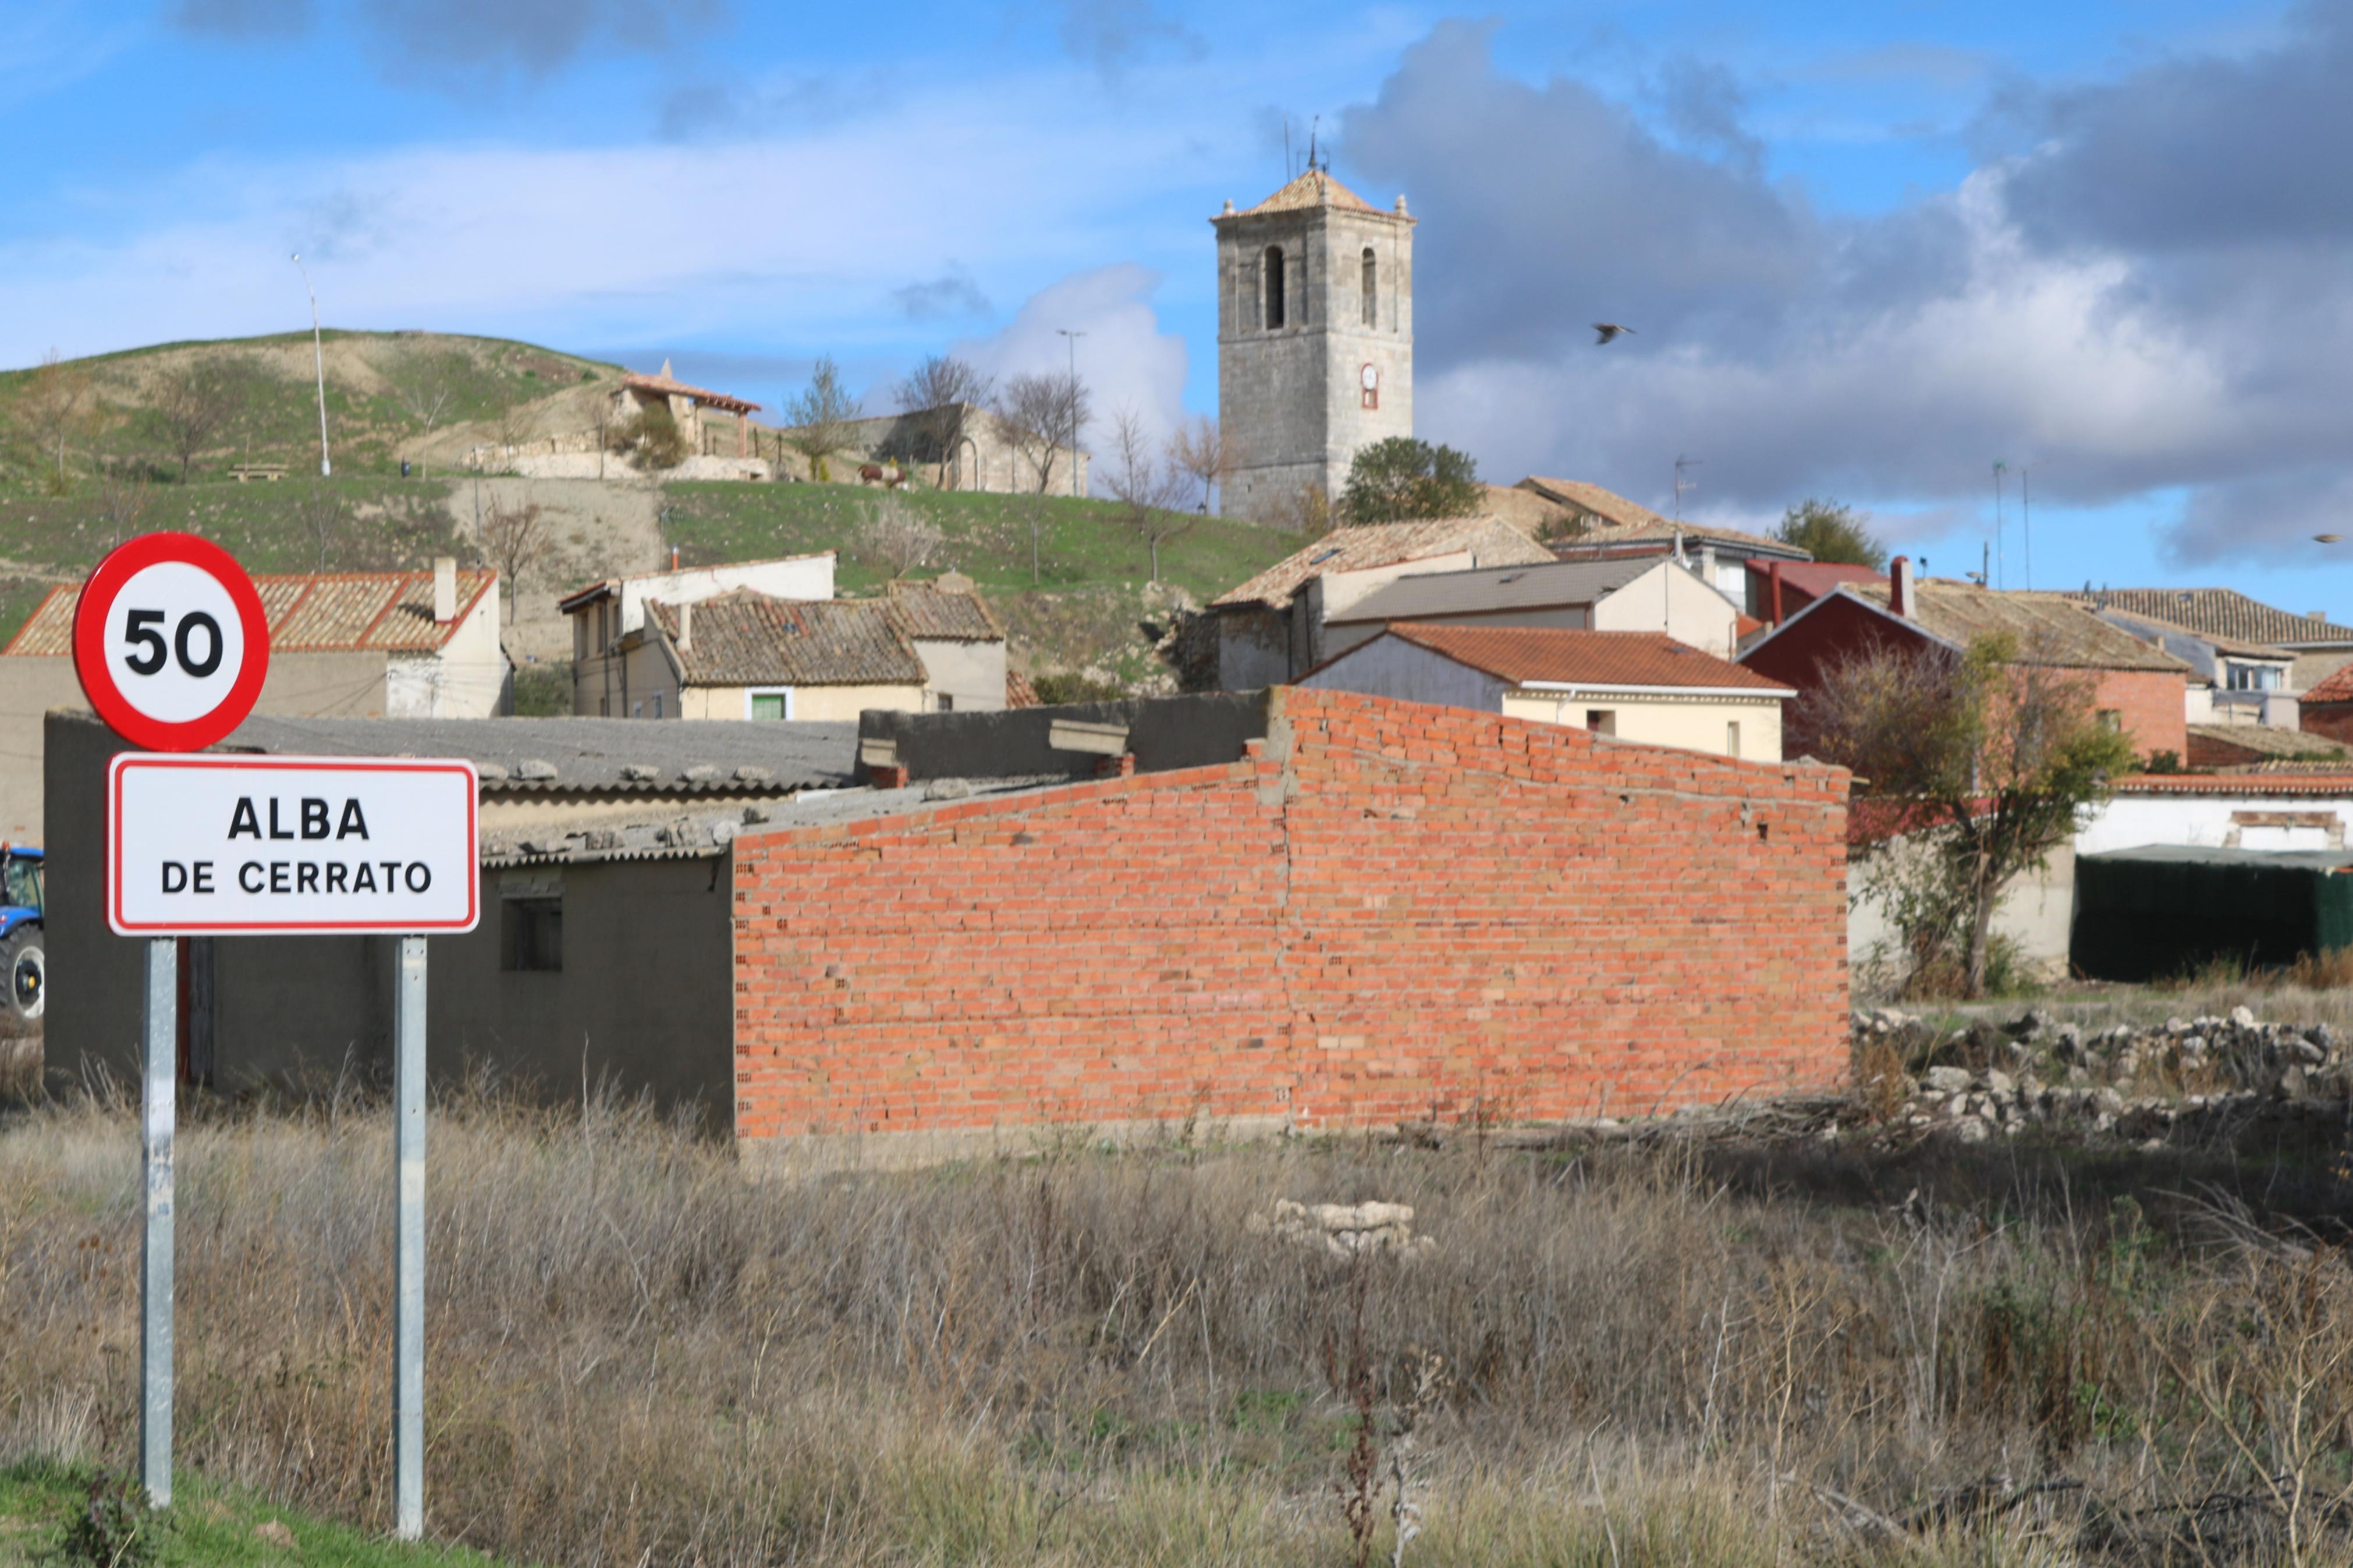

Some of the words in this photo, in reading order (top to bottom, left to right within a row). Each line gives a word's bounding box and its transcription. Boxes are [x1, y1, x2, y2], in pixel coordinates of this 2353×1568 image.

[125, 609, 223, 678] 50
[228, 797, 370, 840] ALBA
[162, 862, 215, 893] DE
[239, 862, 432, 894] CERRATO
